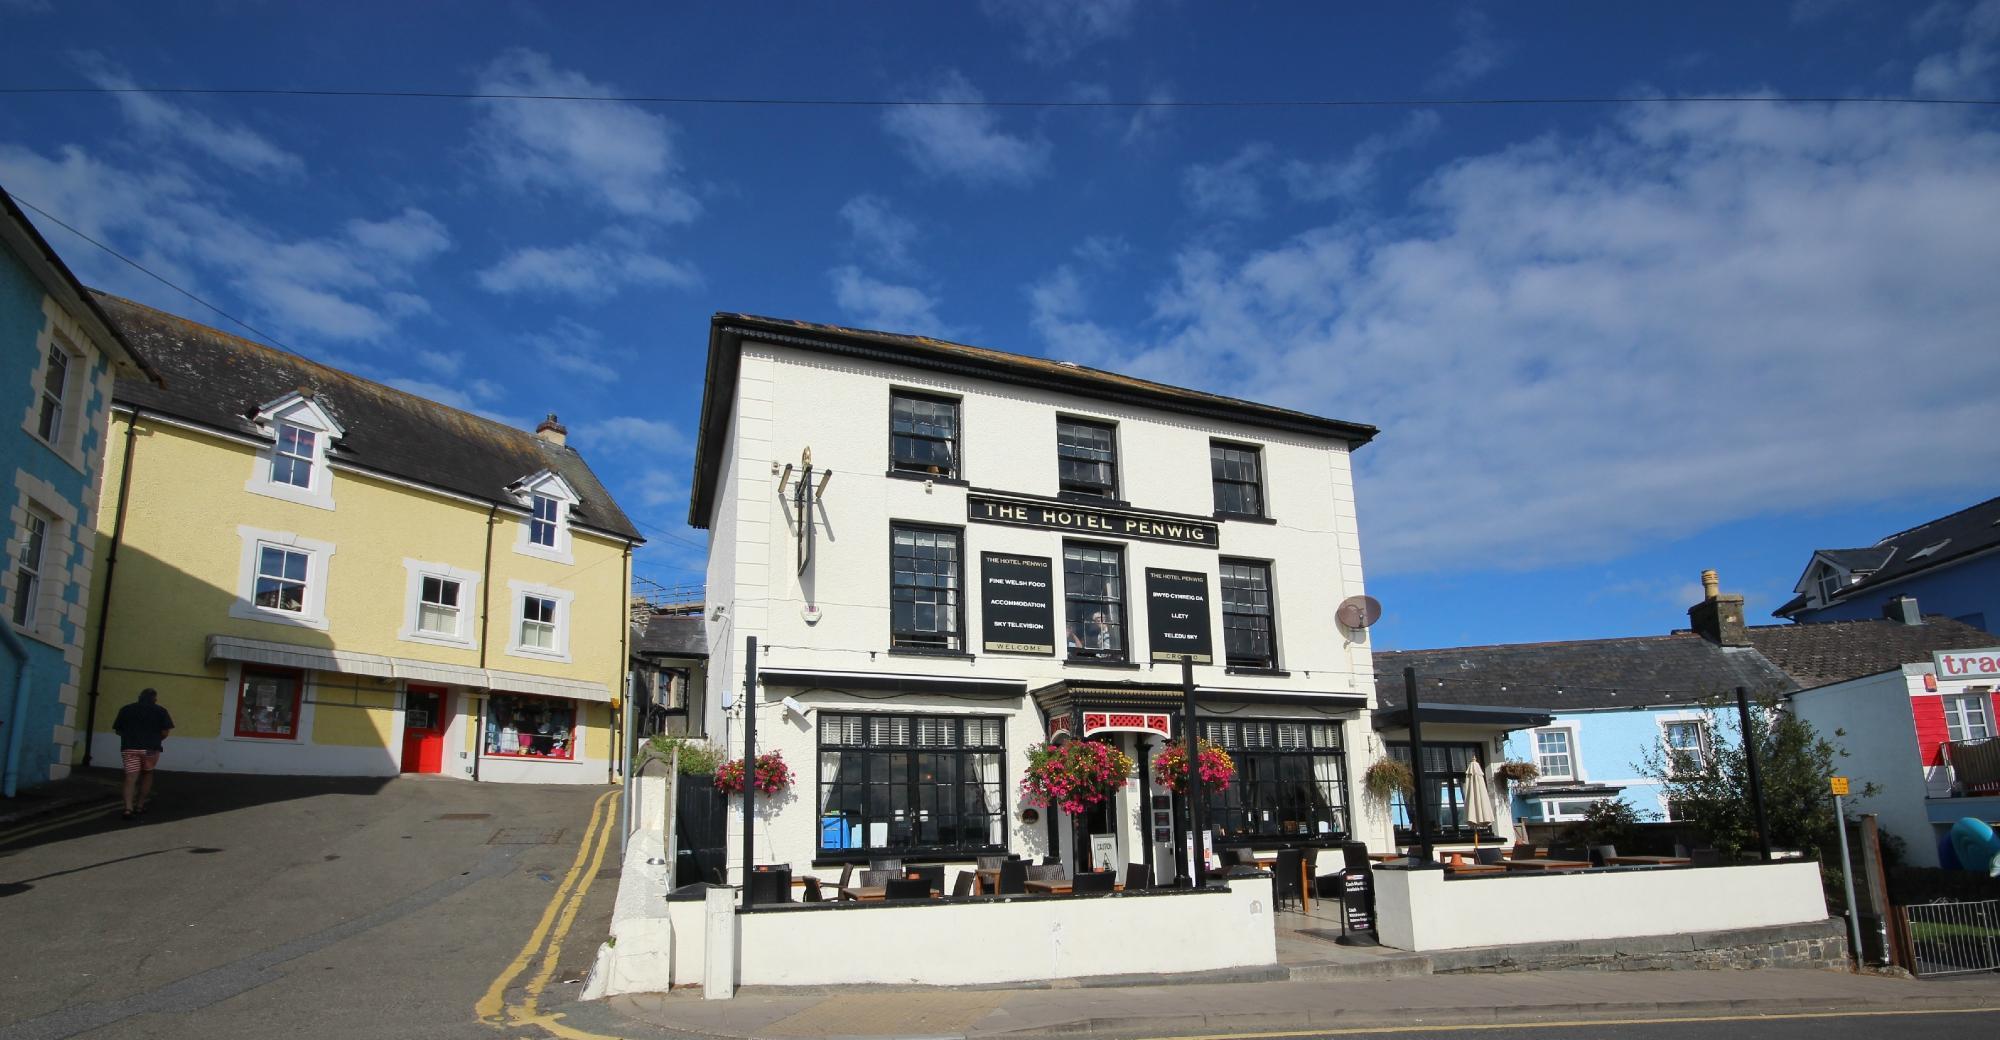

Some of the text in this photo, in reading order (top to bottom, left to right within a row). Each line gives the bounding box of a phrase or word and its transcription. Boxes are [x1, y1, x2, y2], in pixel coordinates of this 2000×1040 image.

[985, 503, 1204, 540] THE HOTEL PENWIG
[1022, 560, 1048, 568] PENWIG
[1162, 573, 1182, 581] HOTEL
[1182, 575, 1204, 583] PENWIG
[1005, 579, 1028, 587] WELSH
[991, 600, 1045, 608] ACCOMMODATION
[1171, 612, 1188, 620] LLETY
[1008, 622, 1044, 630] TELEVISION
[1164, 632, 1186, 640] TELEDU
[1942, 654, 2000, 675] tra
